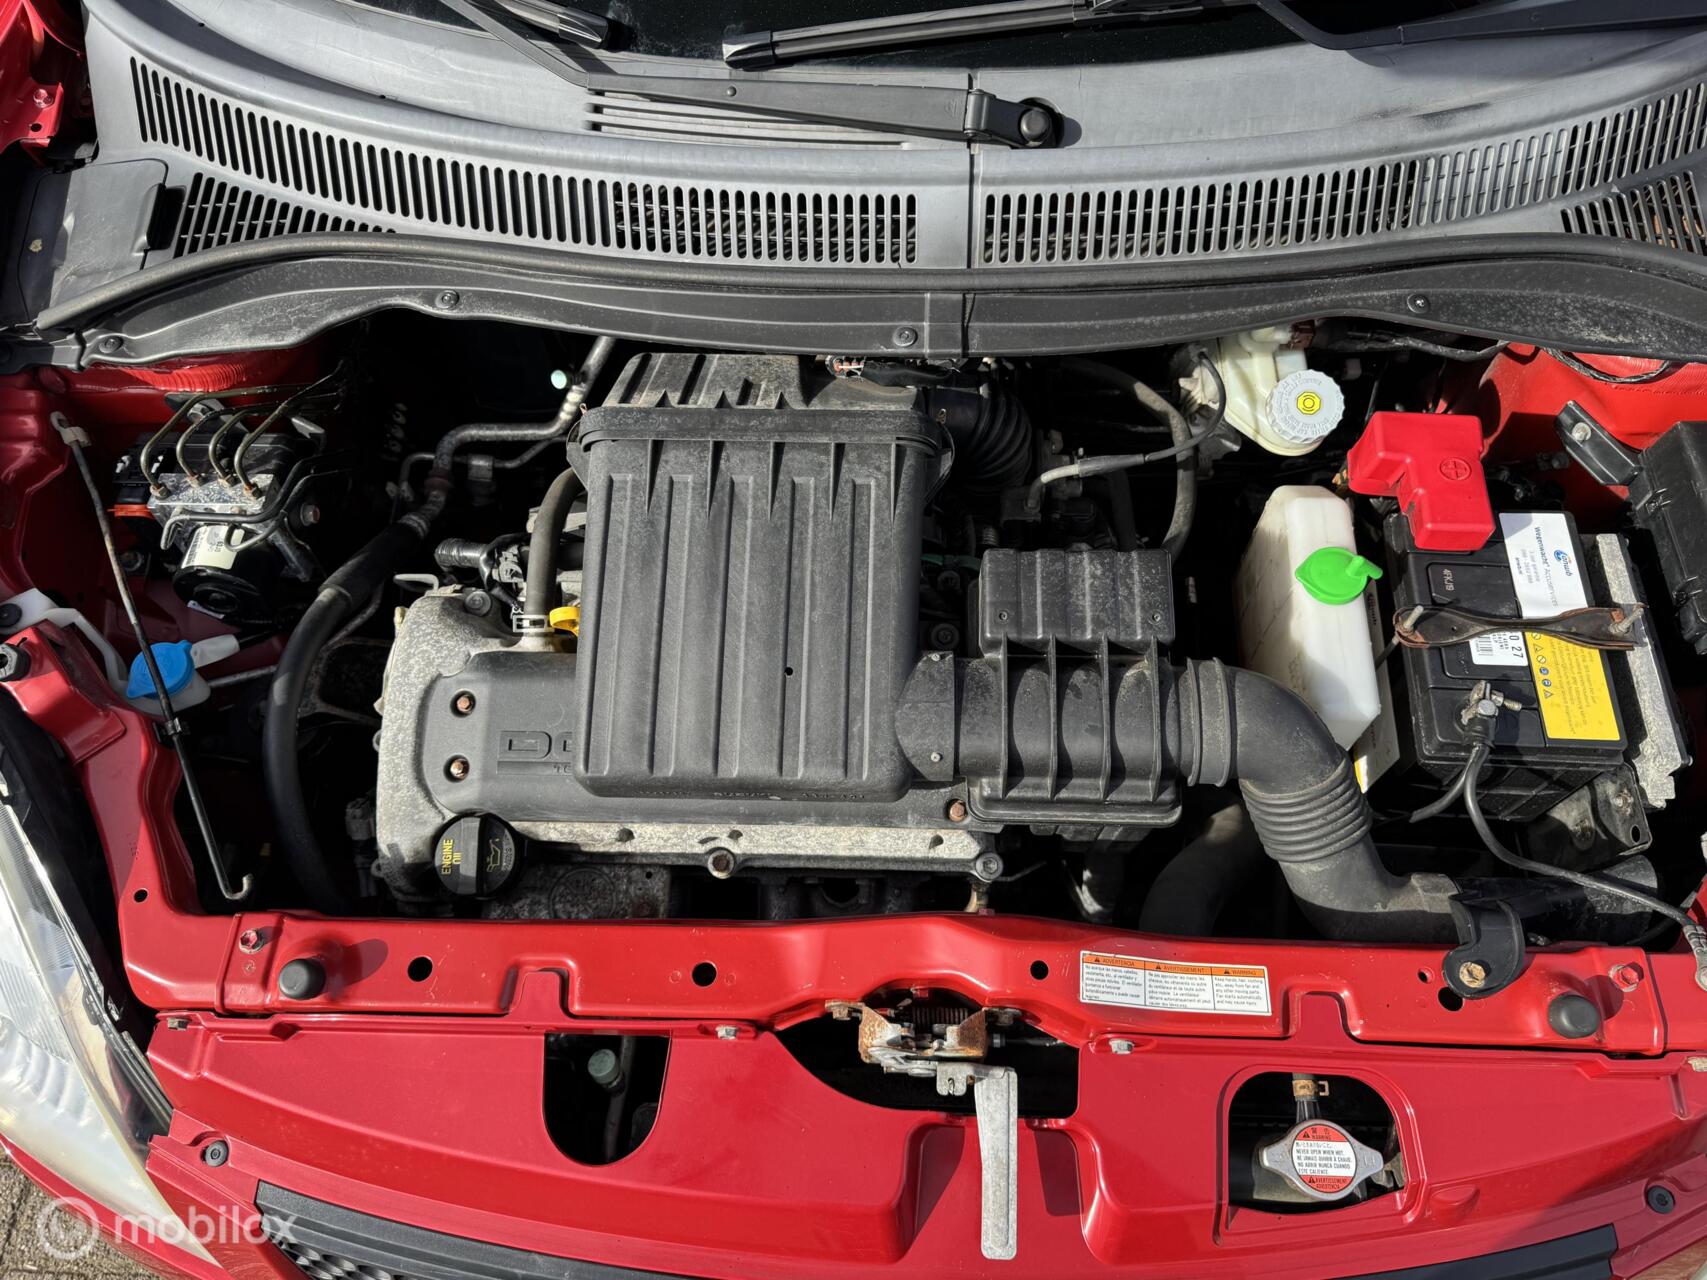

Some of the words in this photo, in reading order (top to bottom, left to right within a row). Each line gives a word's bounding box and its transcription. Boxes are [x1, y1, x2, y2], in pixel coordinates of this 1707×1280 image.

[1512, 646, 1524, 659] 27
[442, 839, 453, 875] ENGINE
[1103, 958, 1135, 966] ADVERTENCIA
